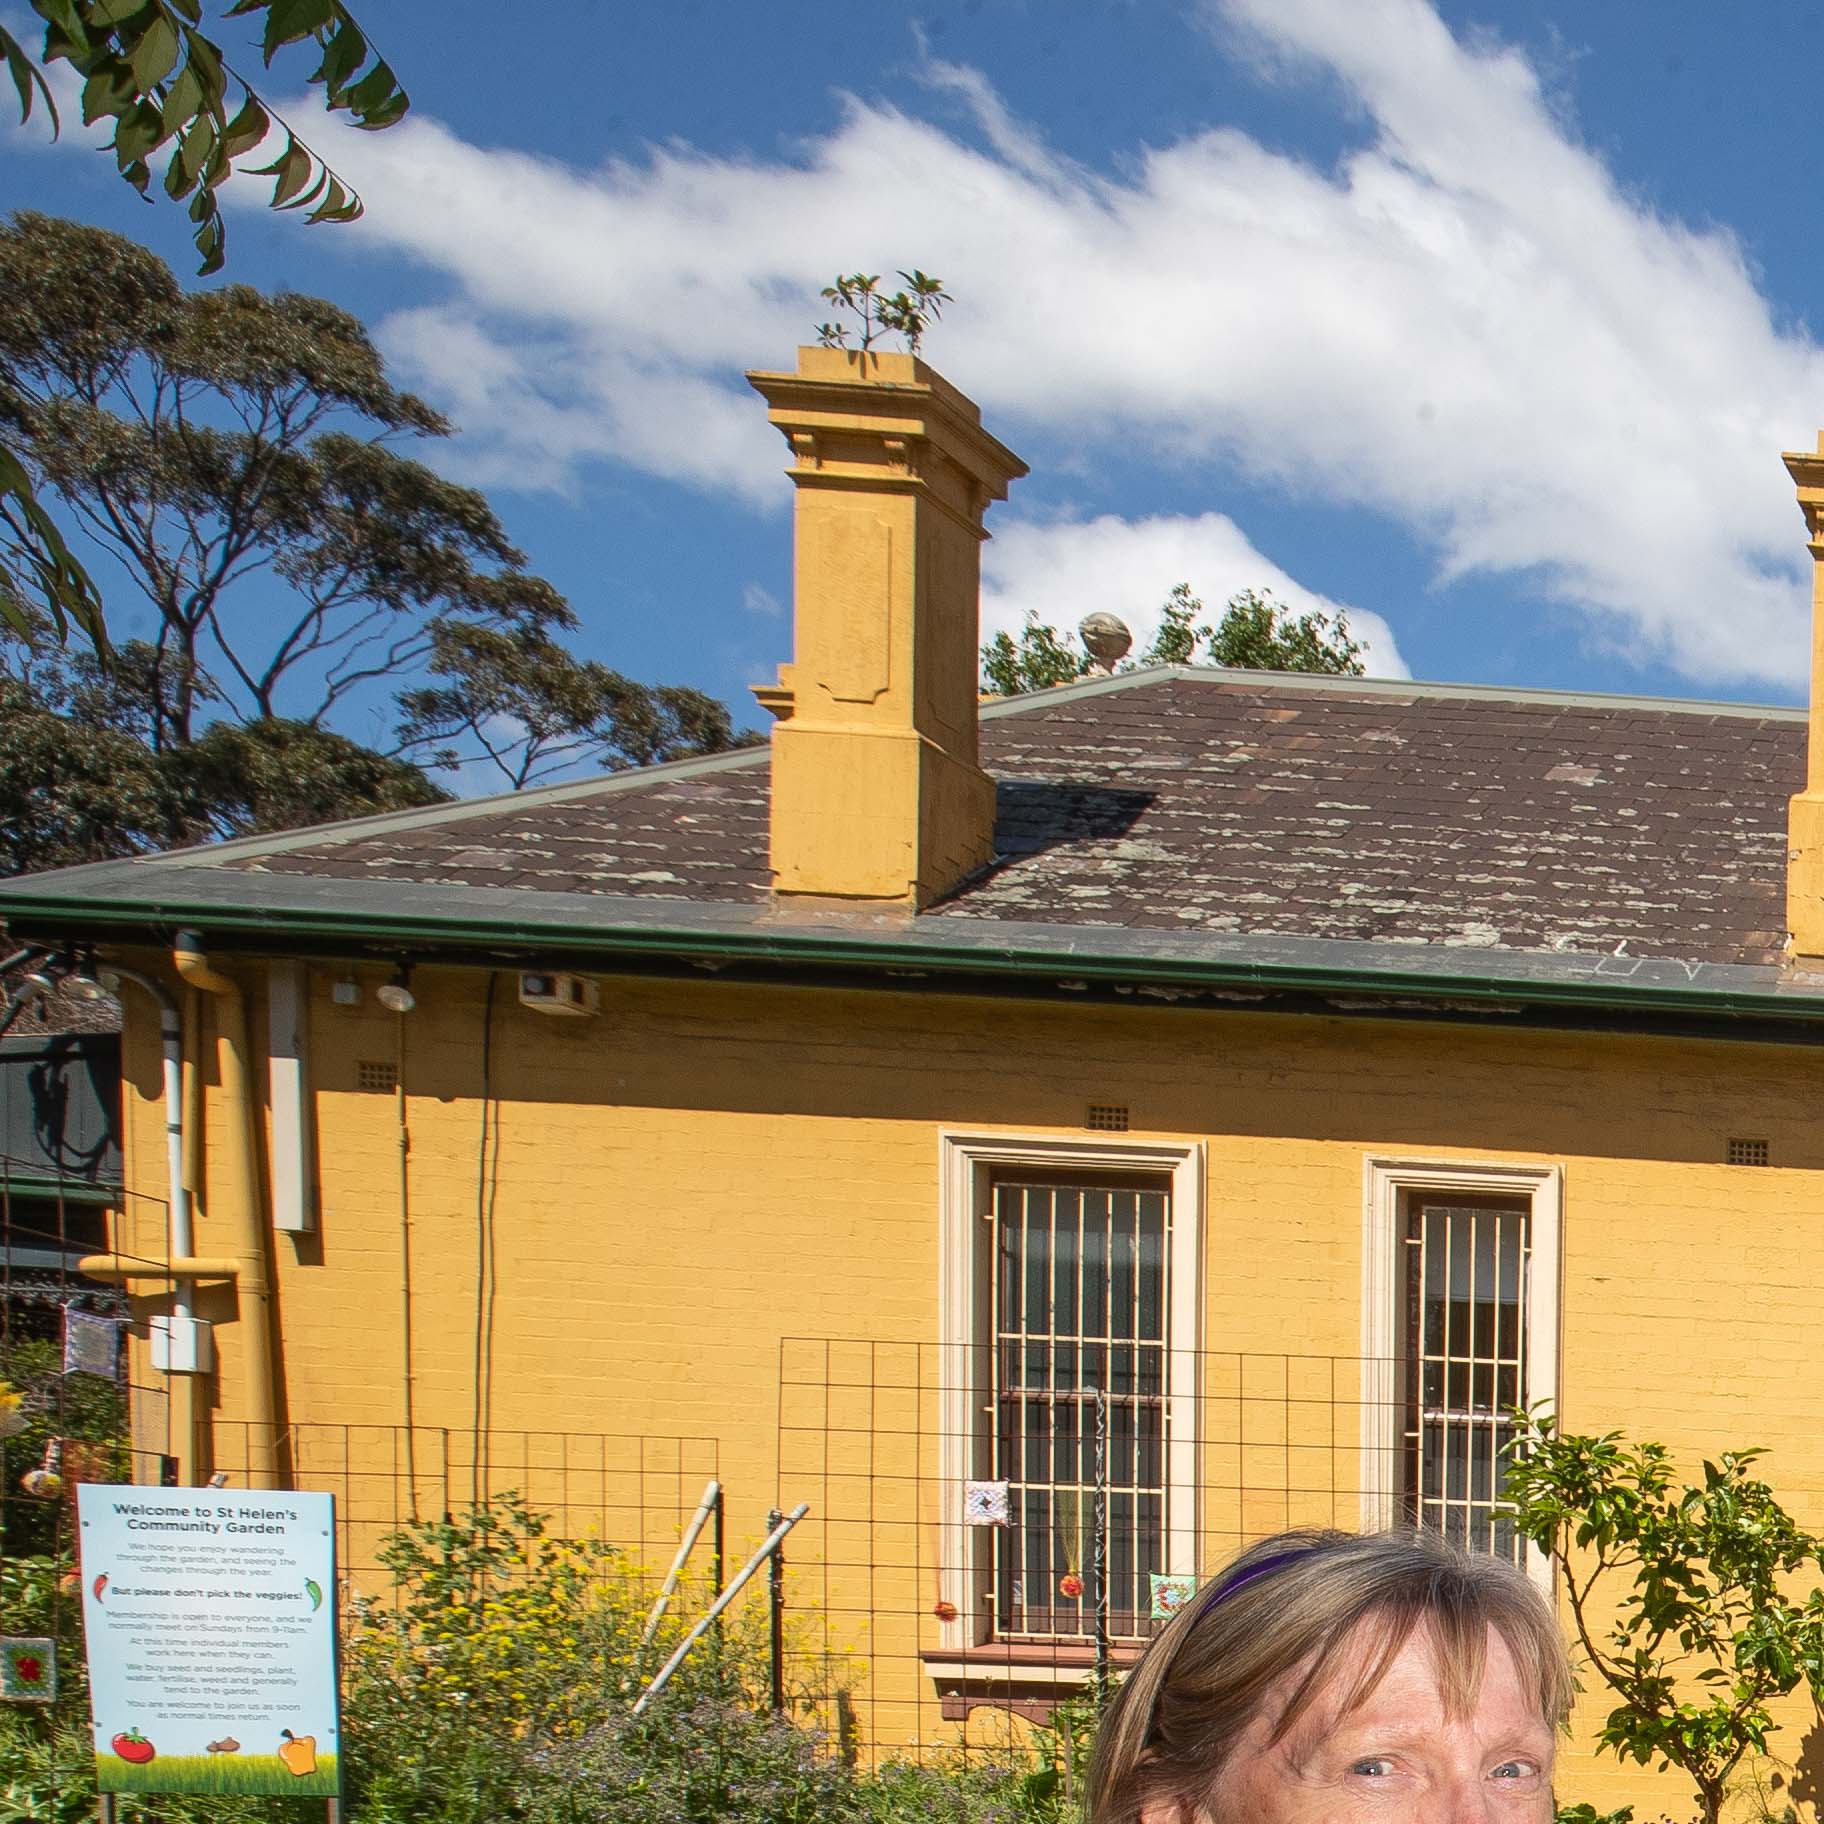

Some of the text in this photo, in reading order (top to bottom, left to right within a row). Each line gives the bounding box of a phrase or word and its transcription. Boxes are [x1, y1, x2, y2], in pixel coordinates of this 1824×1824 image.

[113, 1504, 298, 1520] Welcome to St Helen's
[128, 1520, 285, 1534] Community Garden
[129, 1543, 284, 1555] We hope you enjoy wandering
[117, 1553, 296, 1566] through the garden, and seeing the
[140, 1565, 182, 1575] changes
[186, 1566, 227, 1575] through
[230, 1567, 246, 1575] the
[112, 1587, 302, 1600] But please don't pick the veggies!
[107, 1611, 169, 1621] Membership
[172, 1612, 180, 1620] is
[183, 1614, 208, 1623] open
[276, 1615, 295, 1623] and
[108, 1623, 152, 1632] normally
[201, 1624, 241, 1634] Sundays
[245, 1625, 269, 1633] from
[192, 1639, 239, 1648] individual
[242, 1640, 289, 1649] members
[147, 1649, 169, 1657] work
[174, 1649, 195, 1657] here
[200, 1650, 225, 1658] when
[229, 1651, 250, 1659] they
[145, 1664, 163, 1672] buy
[231, 1677, 248, 1685] and
[252, 1677, 298, 1686] generally
[164, 1686, 187, 1694] tend
[204, 1687, 219, 1695] the
[126, 1700, 146, 1708] You
[167, 1702, 211, 1710] welcome
[215, 1702, 224, 1710] to
[228, 1702, 245, 1711] join
[172, 1712, 205, 1720] normal
[209, 1713, 235, 1721] times
